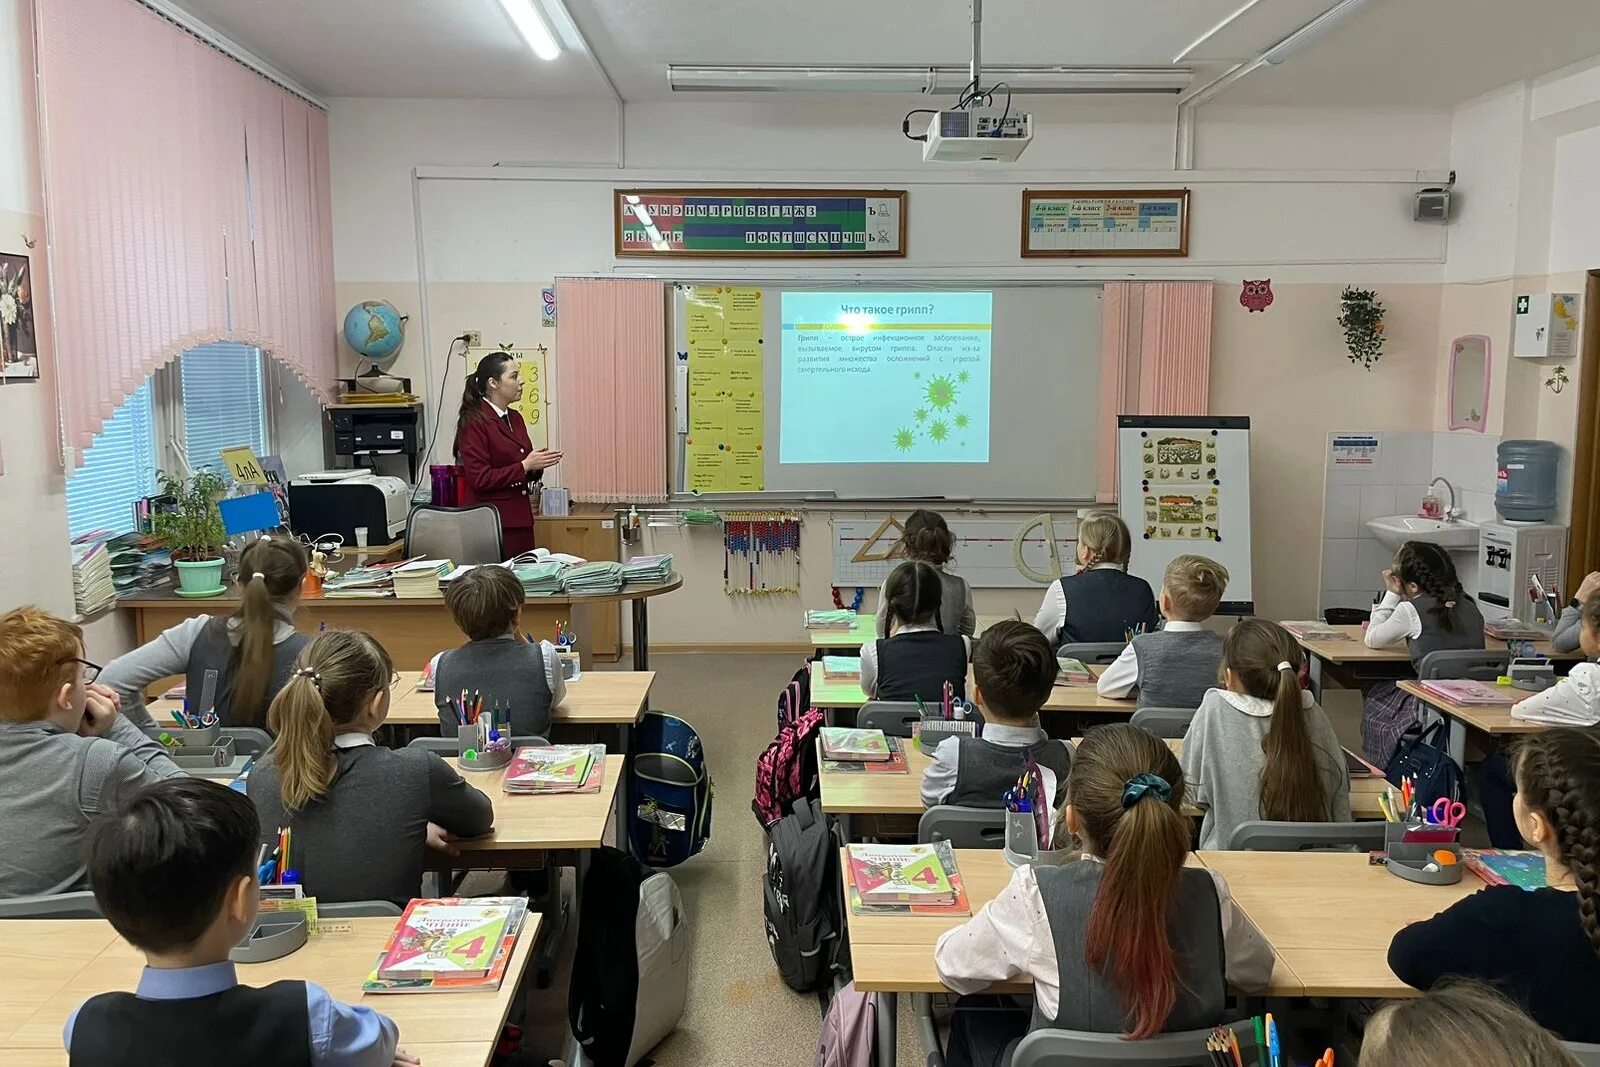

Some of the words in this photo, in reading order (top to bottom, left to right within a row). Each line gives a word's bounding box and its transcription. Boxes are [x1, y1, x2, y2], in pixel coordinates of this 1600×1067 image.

[841, 304, 861, 315] Что
[862, 306, 894, 315] такое
[896, 303, 935, 316] грипп?
[797, 335, 819, 343] Грипп
[841, 335, 864, 343] острое
[873, 334, 925, 343] инфекционное
[852, 345, 882, 353] вирусом
[926, 344, 952, 352] Опасен
[886, 355, 930, 363] осложнений
[952, 355, 980, 363] угрозой
[529, 366, 539, 382] 3
[797, 366, 846, 374] смертельного
[847, 366, 873, 374] исхода.
[529, 388, 539, 404] 6
[530, 408, 540, 425] 9
[554, 764, 577, 776] 4
[912, 866, 939, 885] 4
[452, 935, 486, 958] 4
